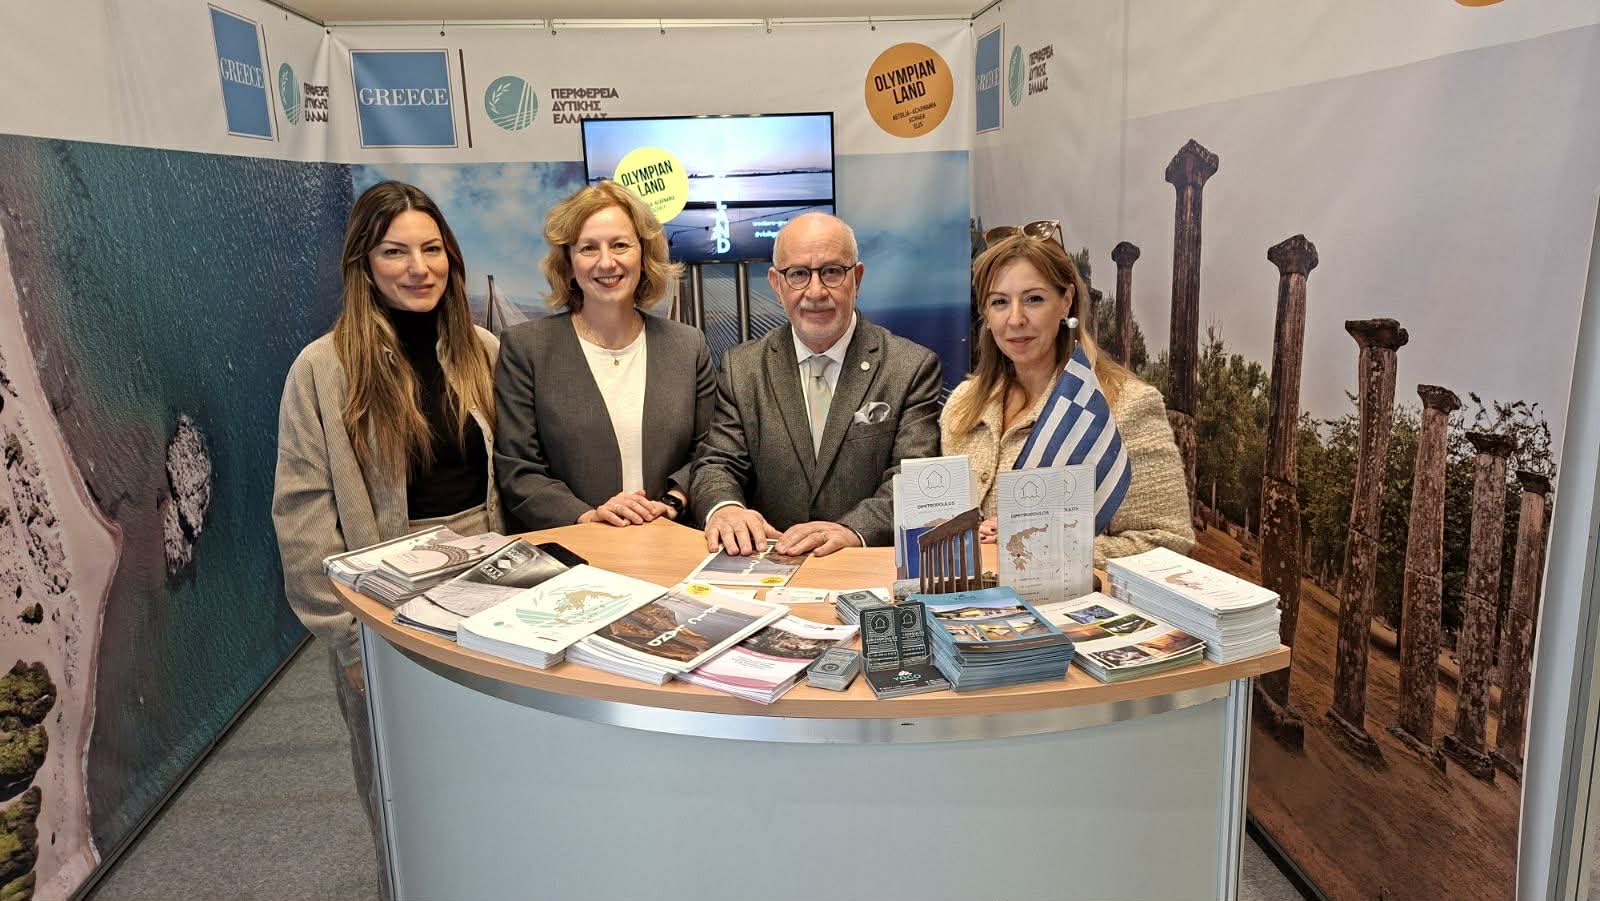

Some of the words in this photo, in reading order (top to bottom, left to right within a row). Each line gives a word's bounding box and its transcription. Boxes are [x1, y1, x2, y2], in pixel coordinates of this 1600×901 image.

[220, 58, 264, 88] GREECE
[874, 59, 936, 92] OLYMPIAN
[360, 87, 449, 106] GREECE
[551, 88, 619, 99] ΠΕΡΙΦΕΡΕΙΑ
[893, 80, 926, 104] LAND
[552, 101, 601, 111] ΔΥΤΙΚΗΣ
[621, 160, 673, 186] OLYMPIAN
[637, 178, 666, 197] LAND
